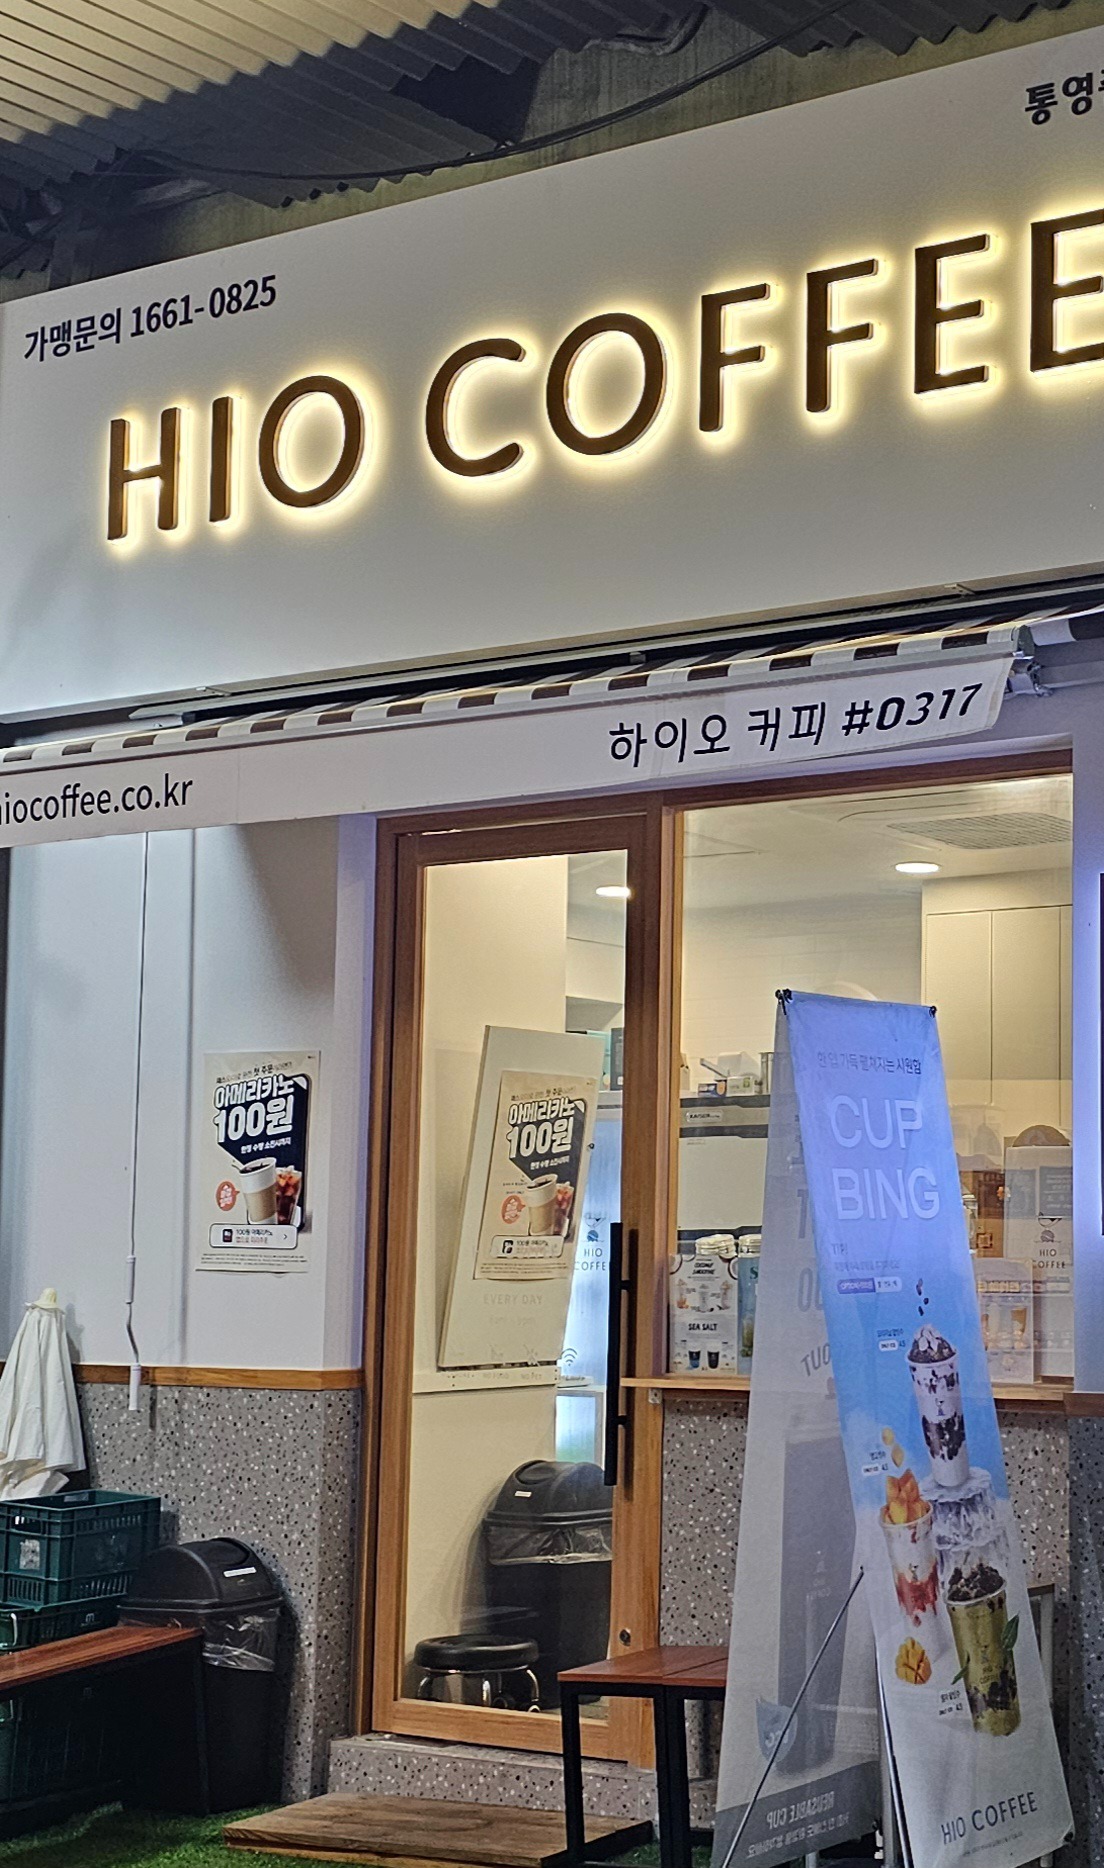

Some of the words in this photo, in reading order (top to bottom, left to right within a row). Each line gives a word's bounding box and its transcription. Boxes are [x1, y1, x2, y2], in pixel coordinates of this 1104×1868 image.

[23, 307, 122, 363] 가맹문의
[130, 275, 276, 338] 1661-0825
[107, 374, 366, 541] HIO
[609, 714, 731, 768] 하이오
[747, 701, 826, 752] 커피
[841, 683, 983, 736] #0317
[214, 1074, 295, 1109] 아메리카노
[508, 1097, 576, 1125] 아메리카노
[214, 1095, 295, 1143] 100원
[506, 1116, 574, 1159] 100원
[829, 1094, 924, 1149] CUP
[832, 1167, 940, 1221] BING
[583, 1247, 603, 1258] HIO
[1039, 1248, 1057, 1258] HIO
[688, 1323, 700, 1331] SEA
[702, 1322, 718, 1331] SALT
[941, 1816, 966, 1845] HIO
[971, 1791, 1038, 1831] COFFEE
